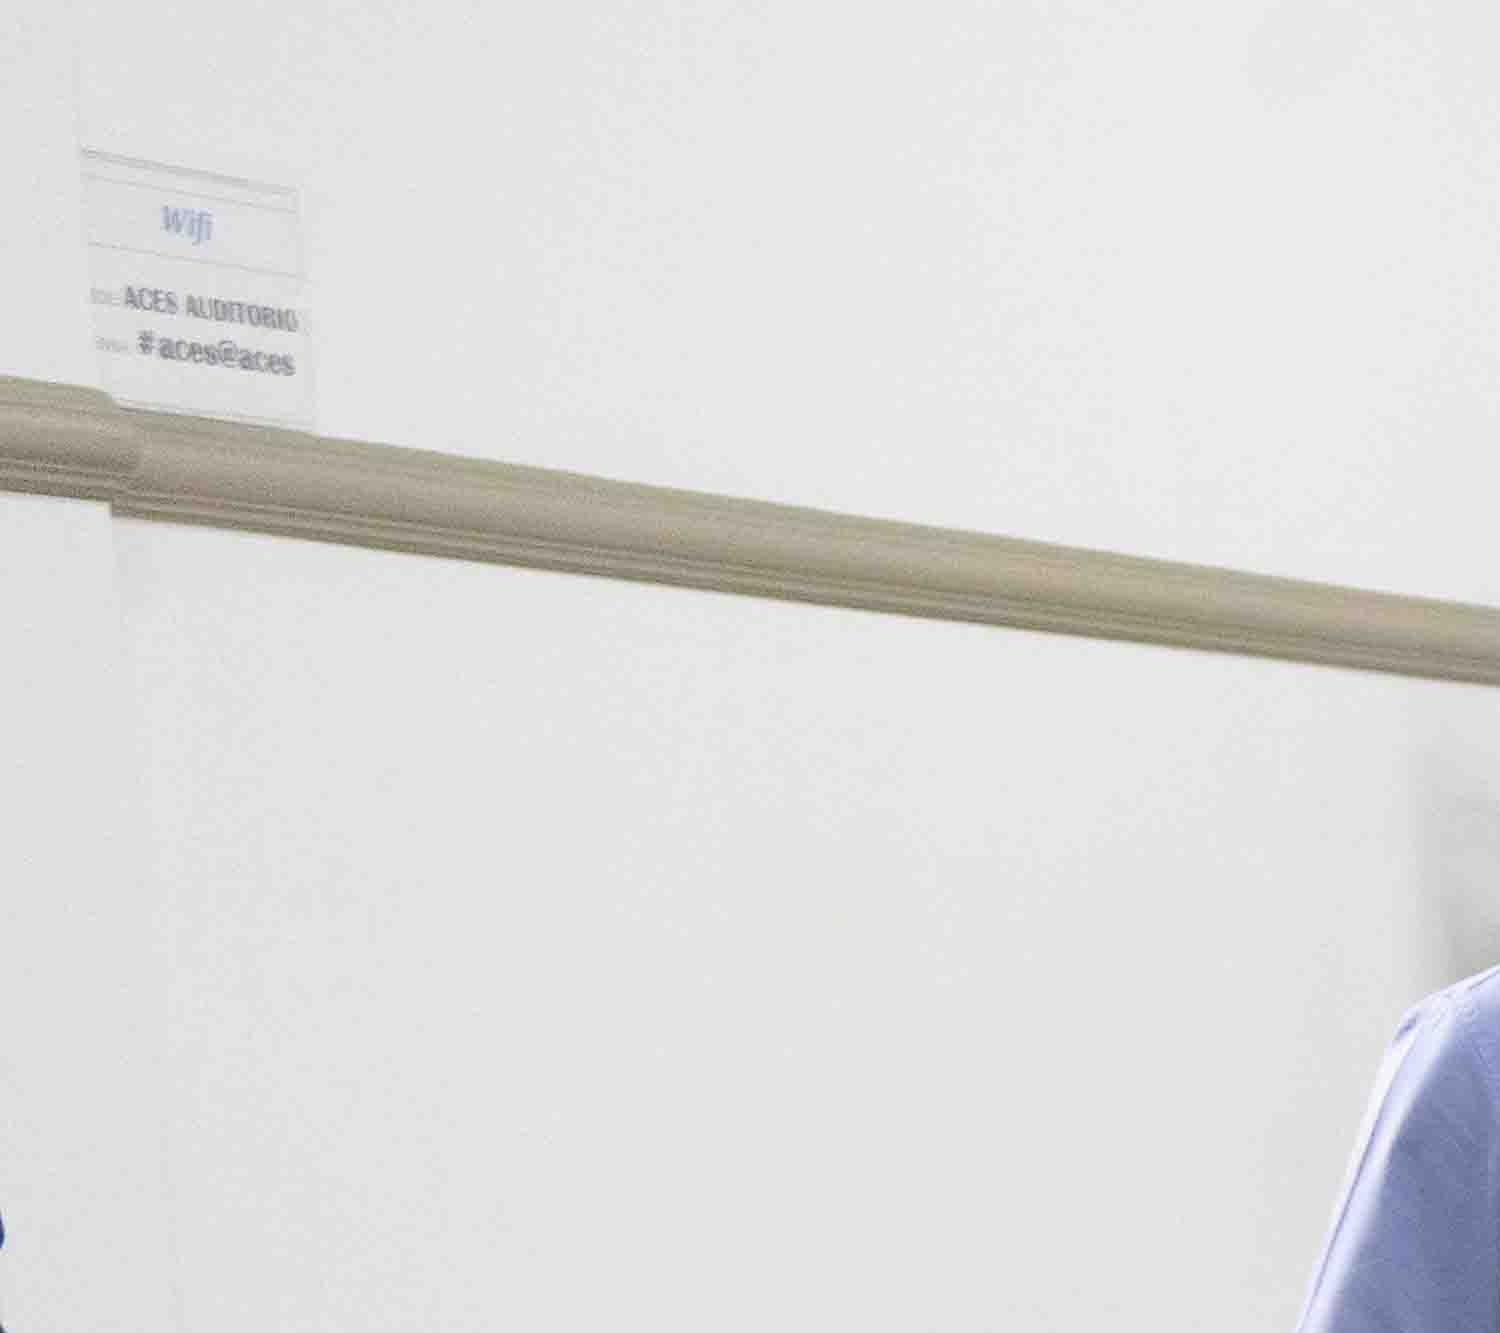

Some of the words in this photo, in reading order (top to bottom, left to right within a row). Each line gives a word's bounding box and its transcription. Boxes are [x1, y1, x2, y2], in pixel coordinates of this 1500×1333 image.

[160, 205, 213, 245] Wifi
[124, 285, 178, 314] ACES
[185, 294, 299, 332] AUDITORIO
